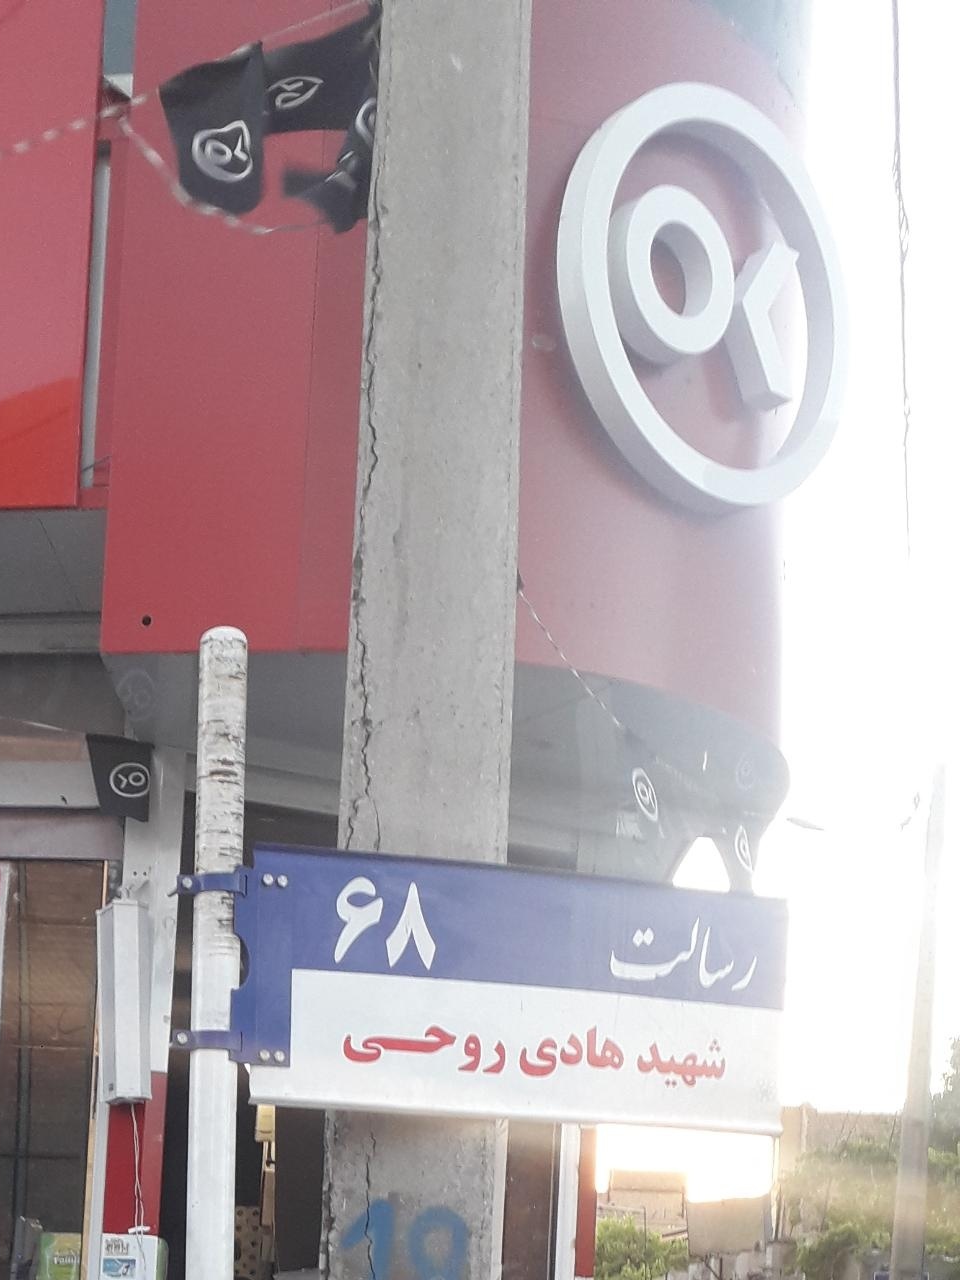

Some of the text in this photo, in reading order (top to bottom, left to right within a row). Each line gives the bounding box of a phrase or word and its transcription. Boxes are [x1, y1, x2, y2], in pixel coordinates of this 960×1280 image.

[334, 876, 758, 992] رسالت ۶۸
[343, 1025, 726, 1087] شهید هادی روحی
